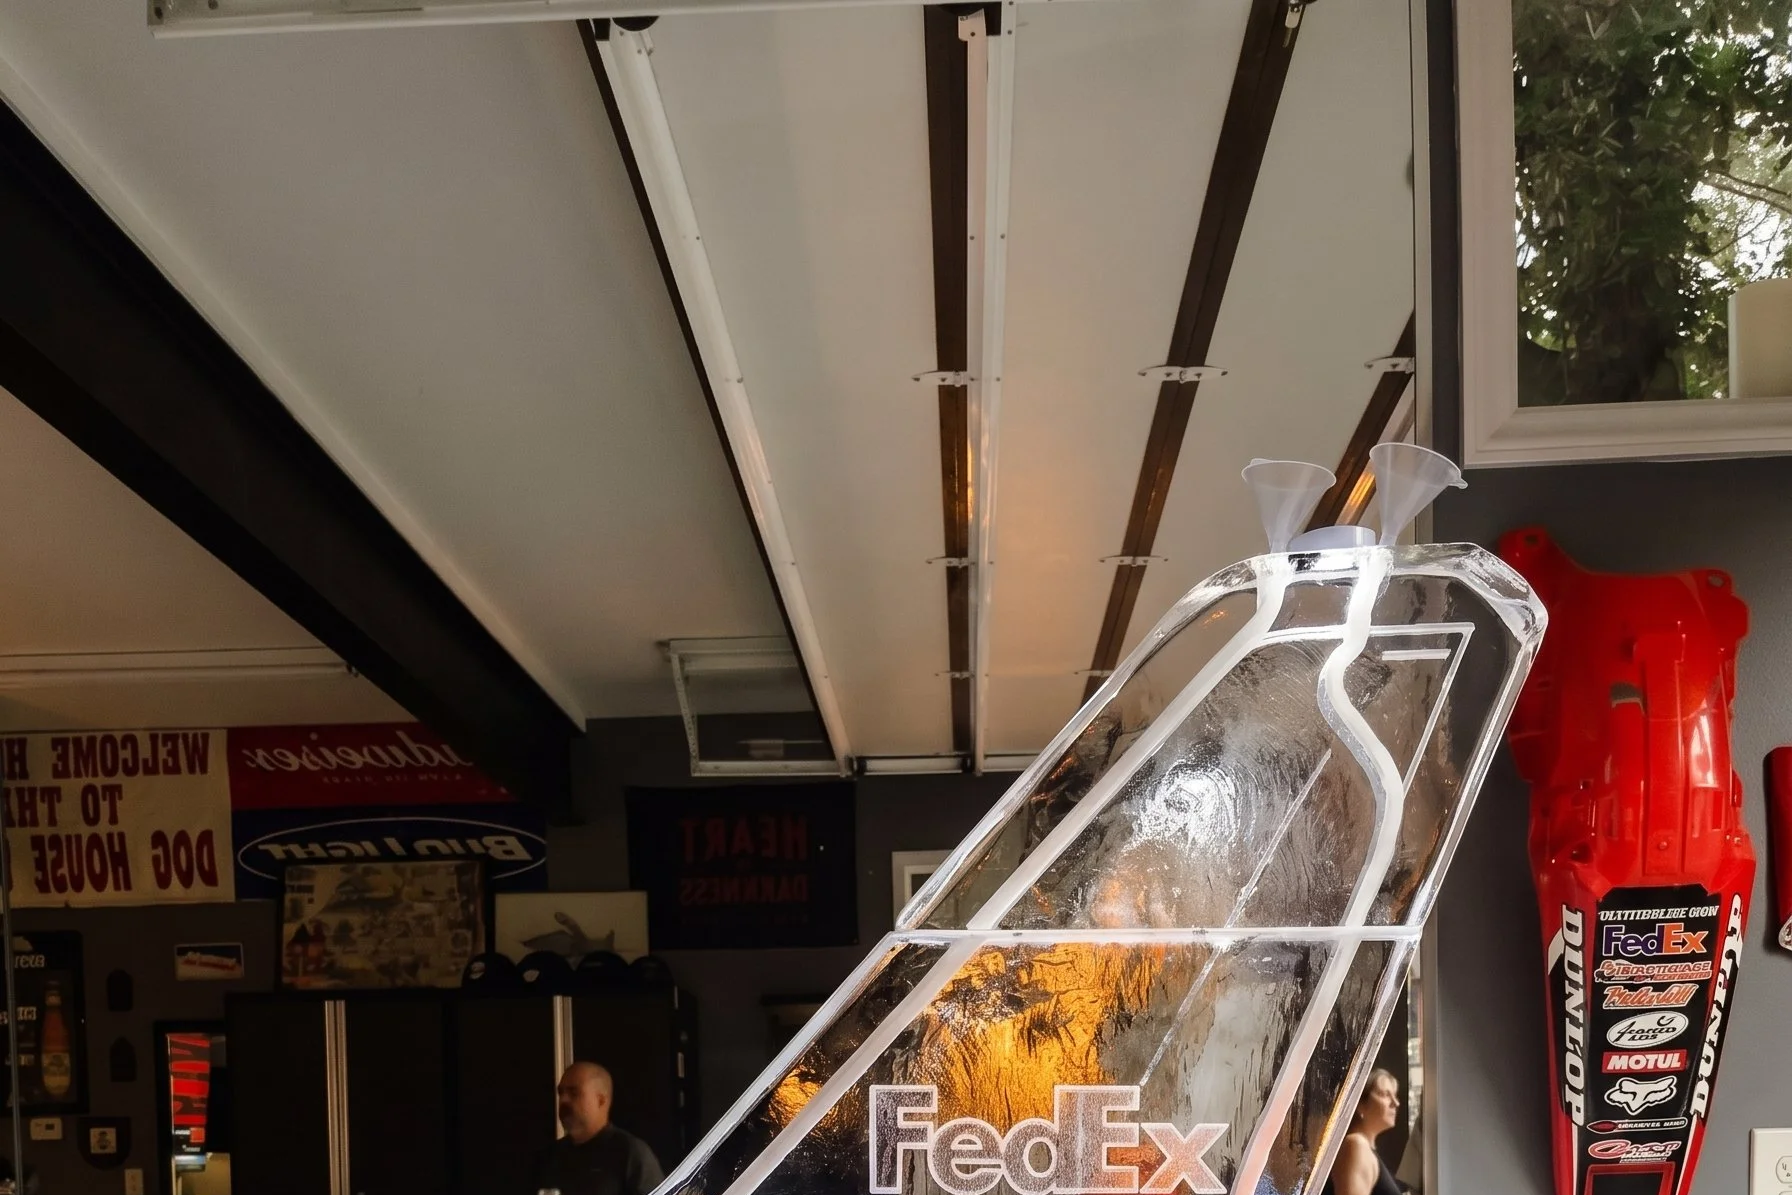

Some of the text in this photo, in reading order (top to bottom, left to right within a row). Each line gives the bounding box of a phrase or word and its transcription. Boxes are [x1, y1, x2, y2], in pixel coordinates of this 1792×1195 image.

[1602, 922, 1709, 957] FedEx
[1562, 903, 1584, 1126] DUNLOP
[1606, 1053, 1681, 1070] MOTUL
